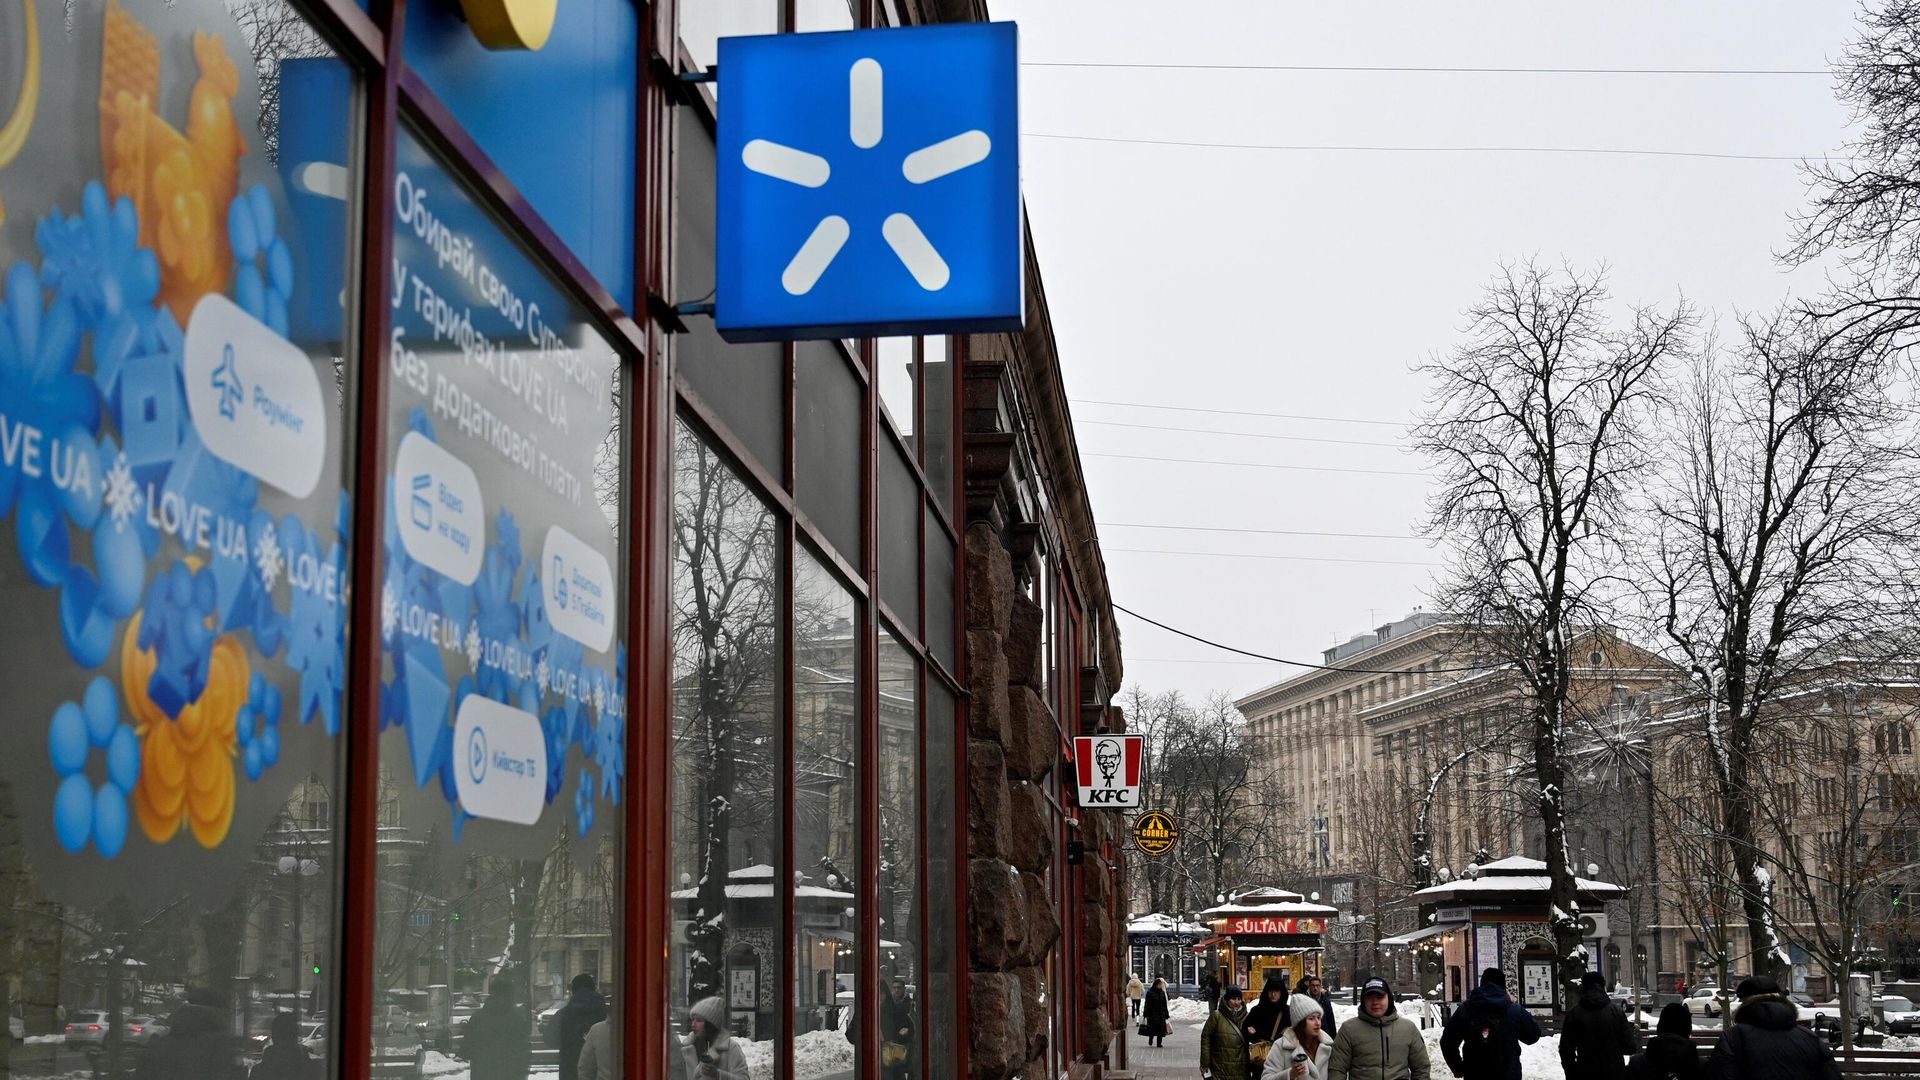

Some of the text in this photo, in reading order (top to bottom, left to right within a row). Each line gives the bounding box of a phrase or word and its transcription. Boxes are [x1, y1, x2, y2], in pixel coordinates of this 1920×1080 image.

[395, 171, 605, 412] Обирай свою Суперсилу
[391, 258, 569, 435] у тарифах LOVE UA
[254, 385, 304, 433] Роумінг
[390, 326, 582, 507] без додаткової плати
[51, 438, 93, 500] UA
[146, 482, 212, 548] LOVE
[216, 514, 249, 562] UA
[287, 548, 337, 603] LOVE
[402, 600, 439, 645] LOVE
[442, 617, 463, 655] UA
[484, 637, 515, 675] LOVE
[519, 651, 532, 679] UA
[551, 665, 577, 700] LOVE
[578, 677, 592, 706] UA
[1087, 789, 1129, 803] KFC
[1142, 829, 1169, 838] CORNER
[1235, 921, 1288, 933] SULTAN
